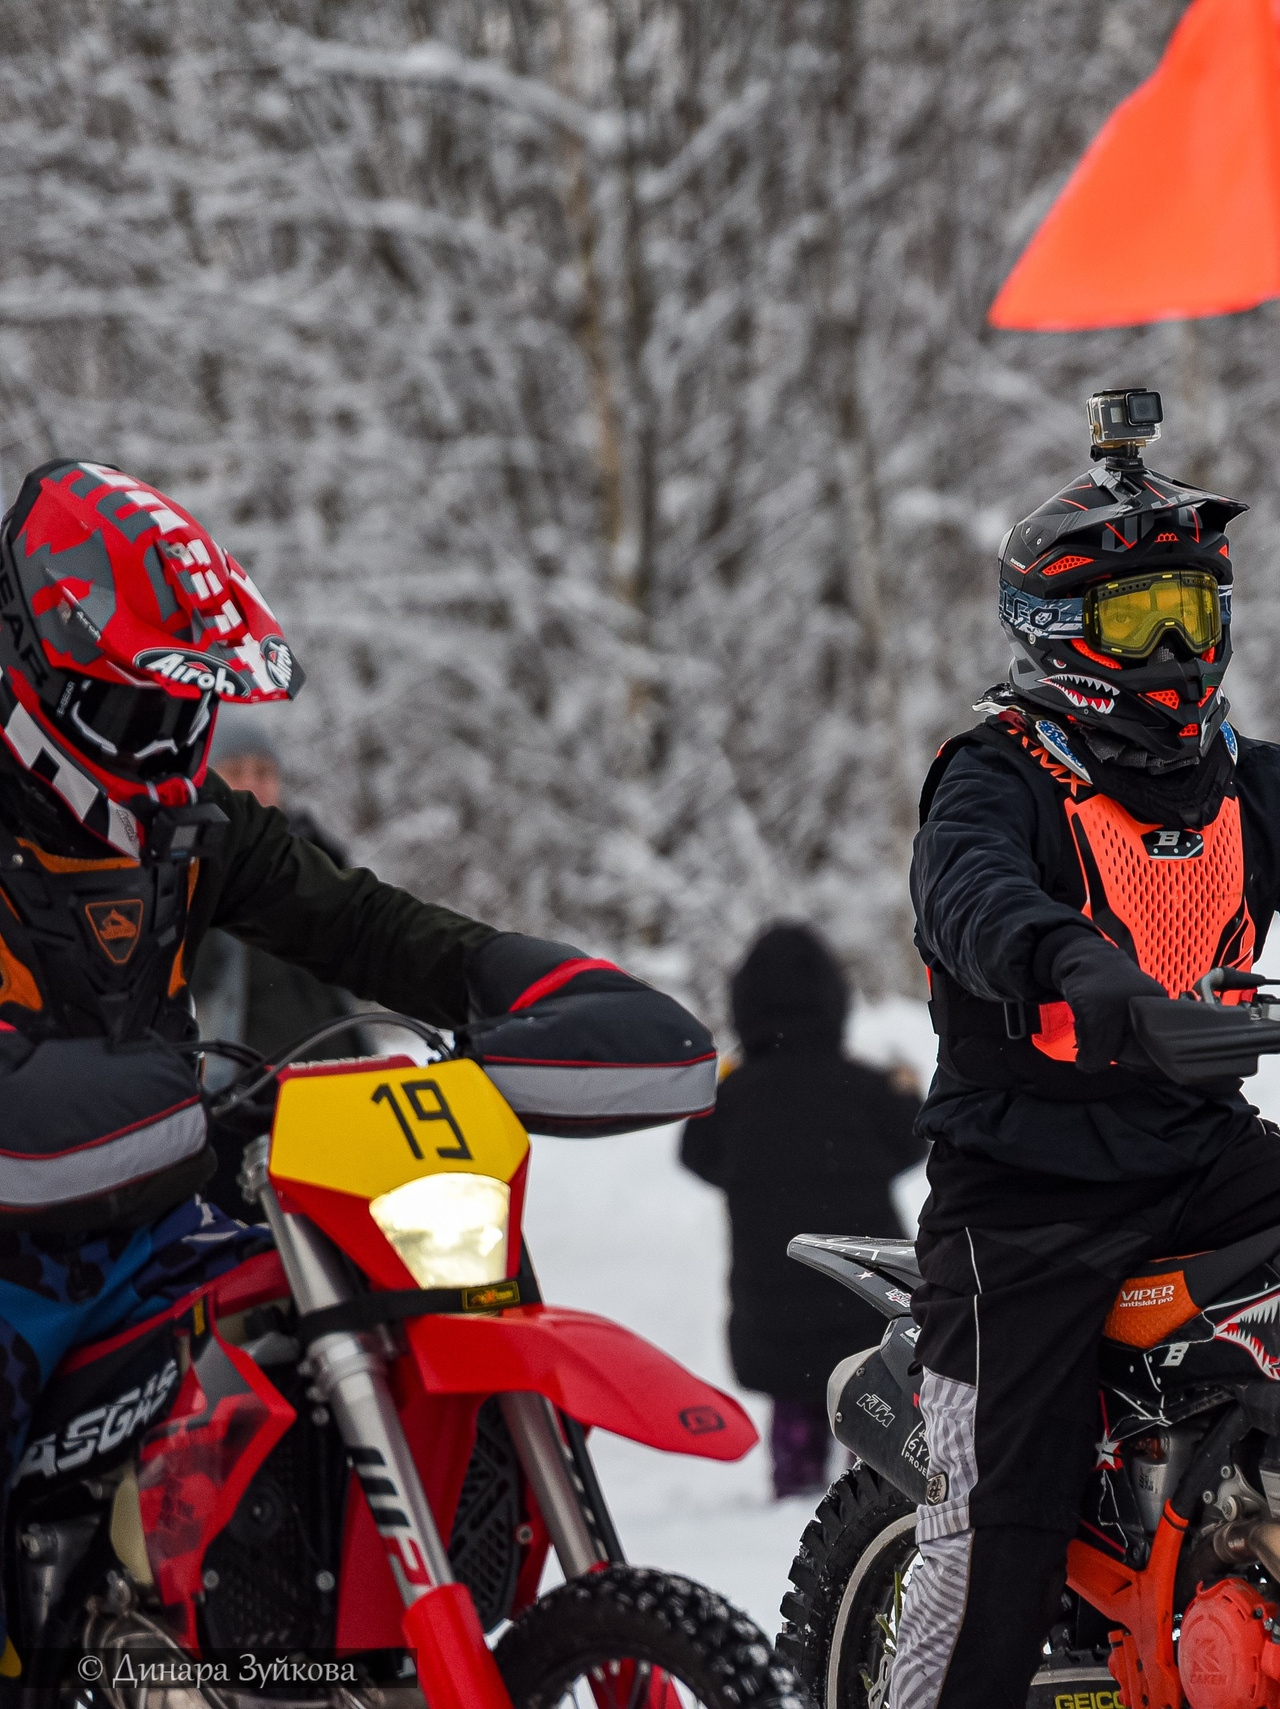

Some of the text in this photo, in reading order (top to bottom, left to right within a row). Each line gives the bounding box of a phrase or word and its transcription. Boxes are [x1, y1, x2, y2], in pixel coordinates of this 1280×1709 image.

[145, 653, 236, 696] Airoh
[371, 1078, 474, 1160] 19
[1121, 1285, 1175, 1301] VIPER
[1158, 1296, 1174, 1306] pro
[856, 1393, 896, 1429] KTM
